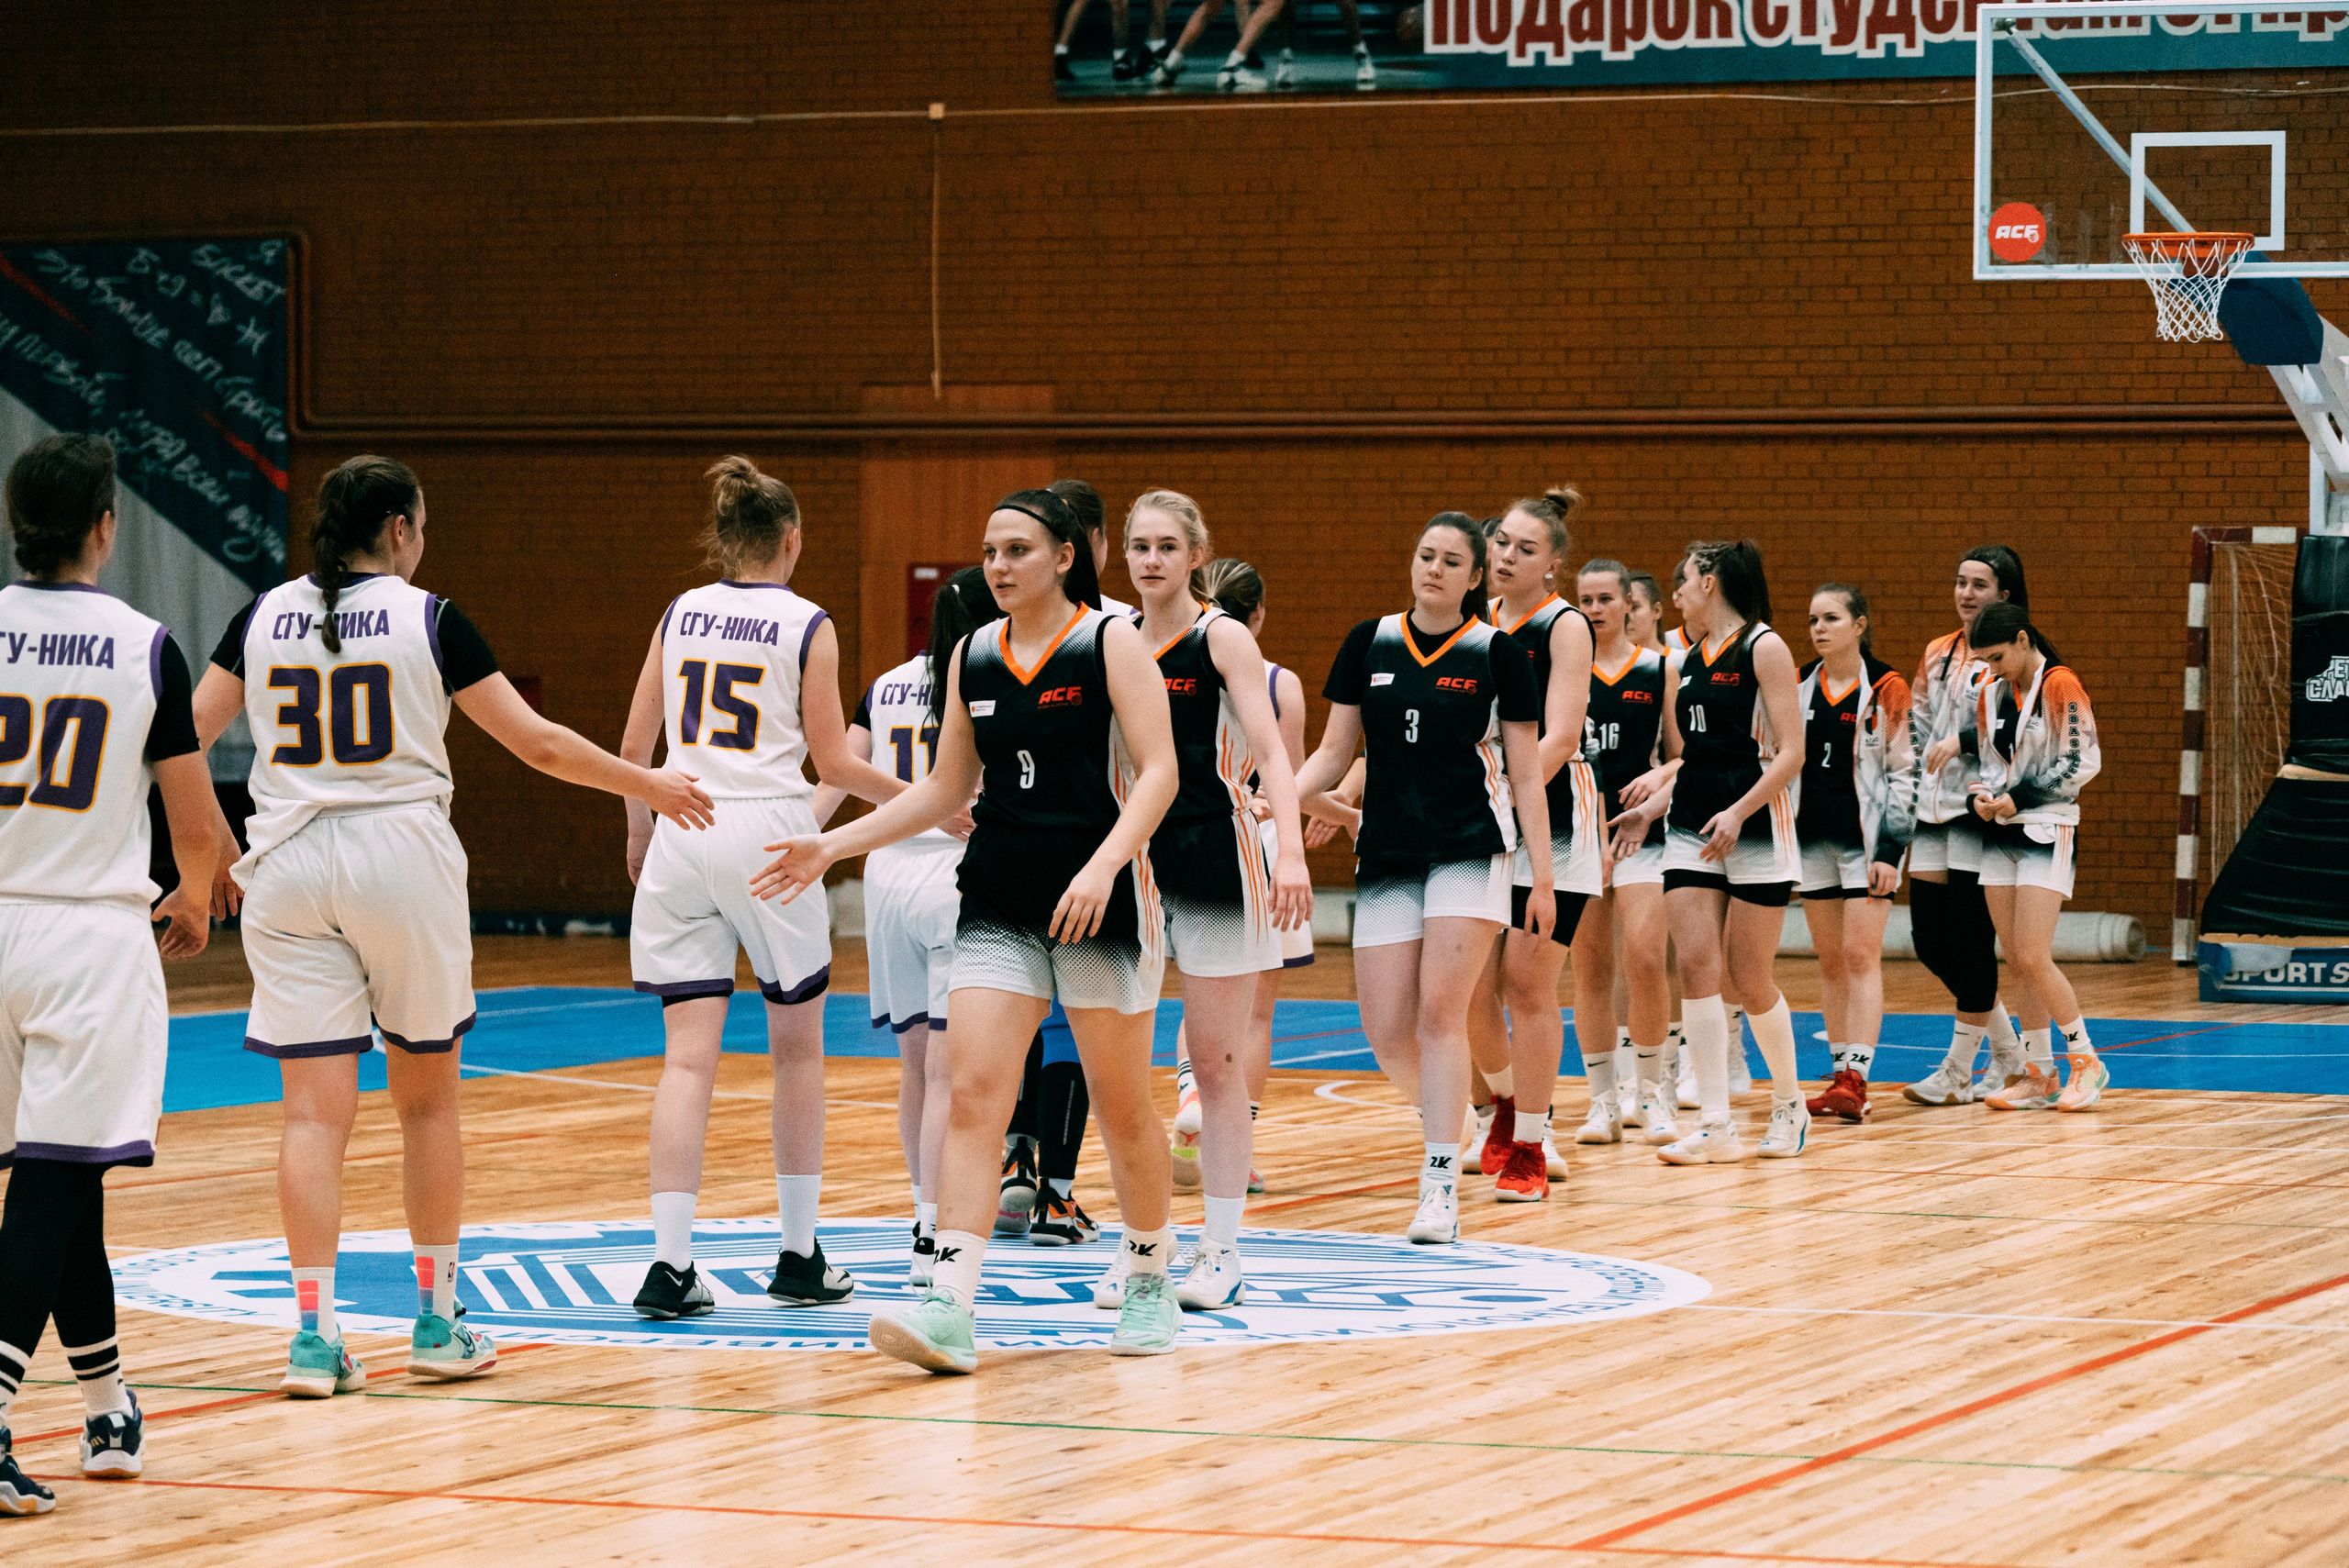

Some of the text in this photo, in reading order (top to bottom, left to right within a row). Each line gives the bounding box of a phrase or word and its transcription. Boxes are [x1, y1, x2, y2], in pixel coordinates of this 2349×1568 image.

[680, 611, 780, 646] СГУ-НИКА
[0, 630, 114, 670] У-НИКА
[677, 658, 766, 752] 15
[880, 683, 934, 706] СГУ-Н
[267, 661, 395, 768] 30
[1405, 708, 1419, 743] 3
[1688, 704, 1707, 733] 10
[1598, 722, 1620, 750] 16
[1017, 750, 1035, 789] 9
[1821, 741, 1831, 769] 2
[1430, 1156, 1453, 1169] 2K
